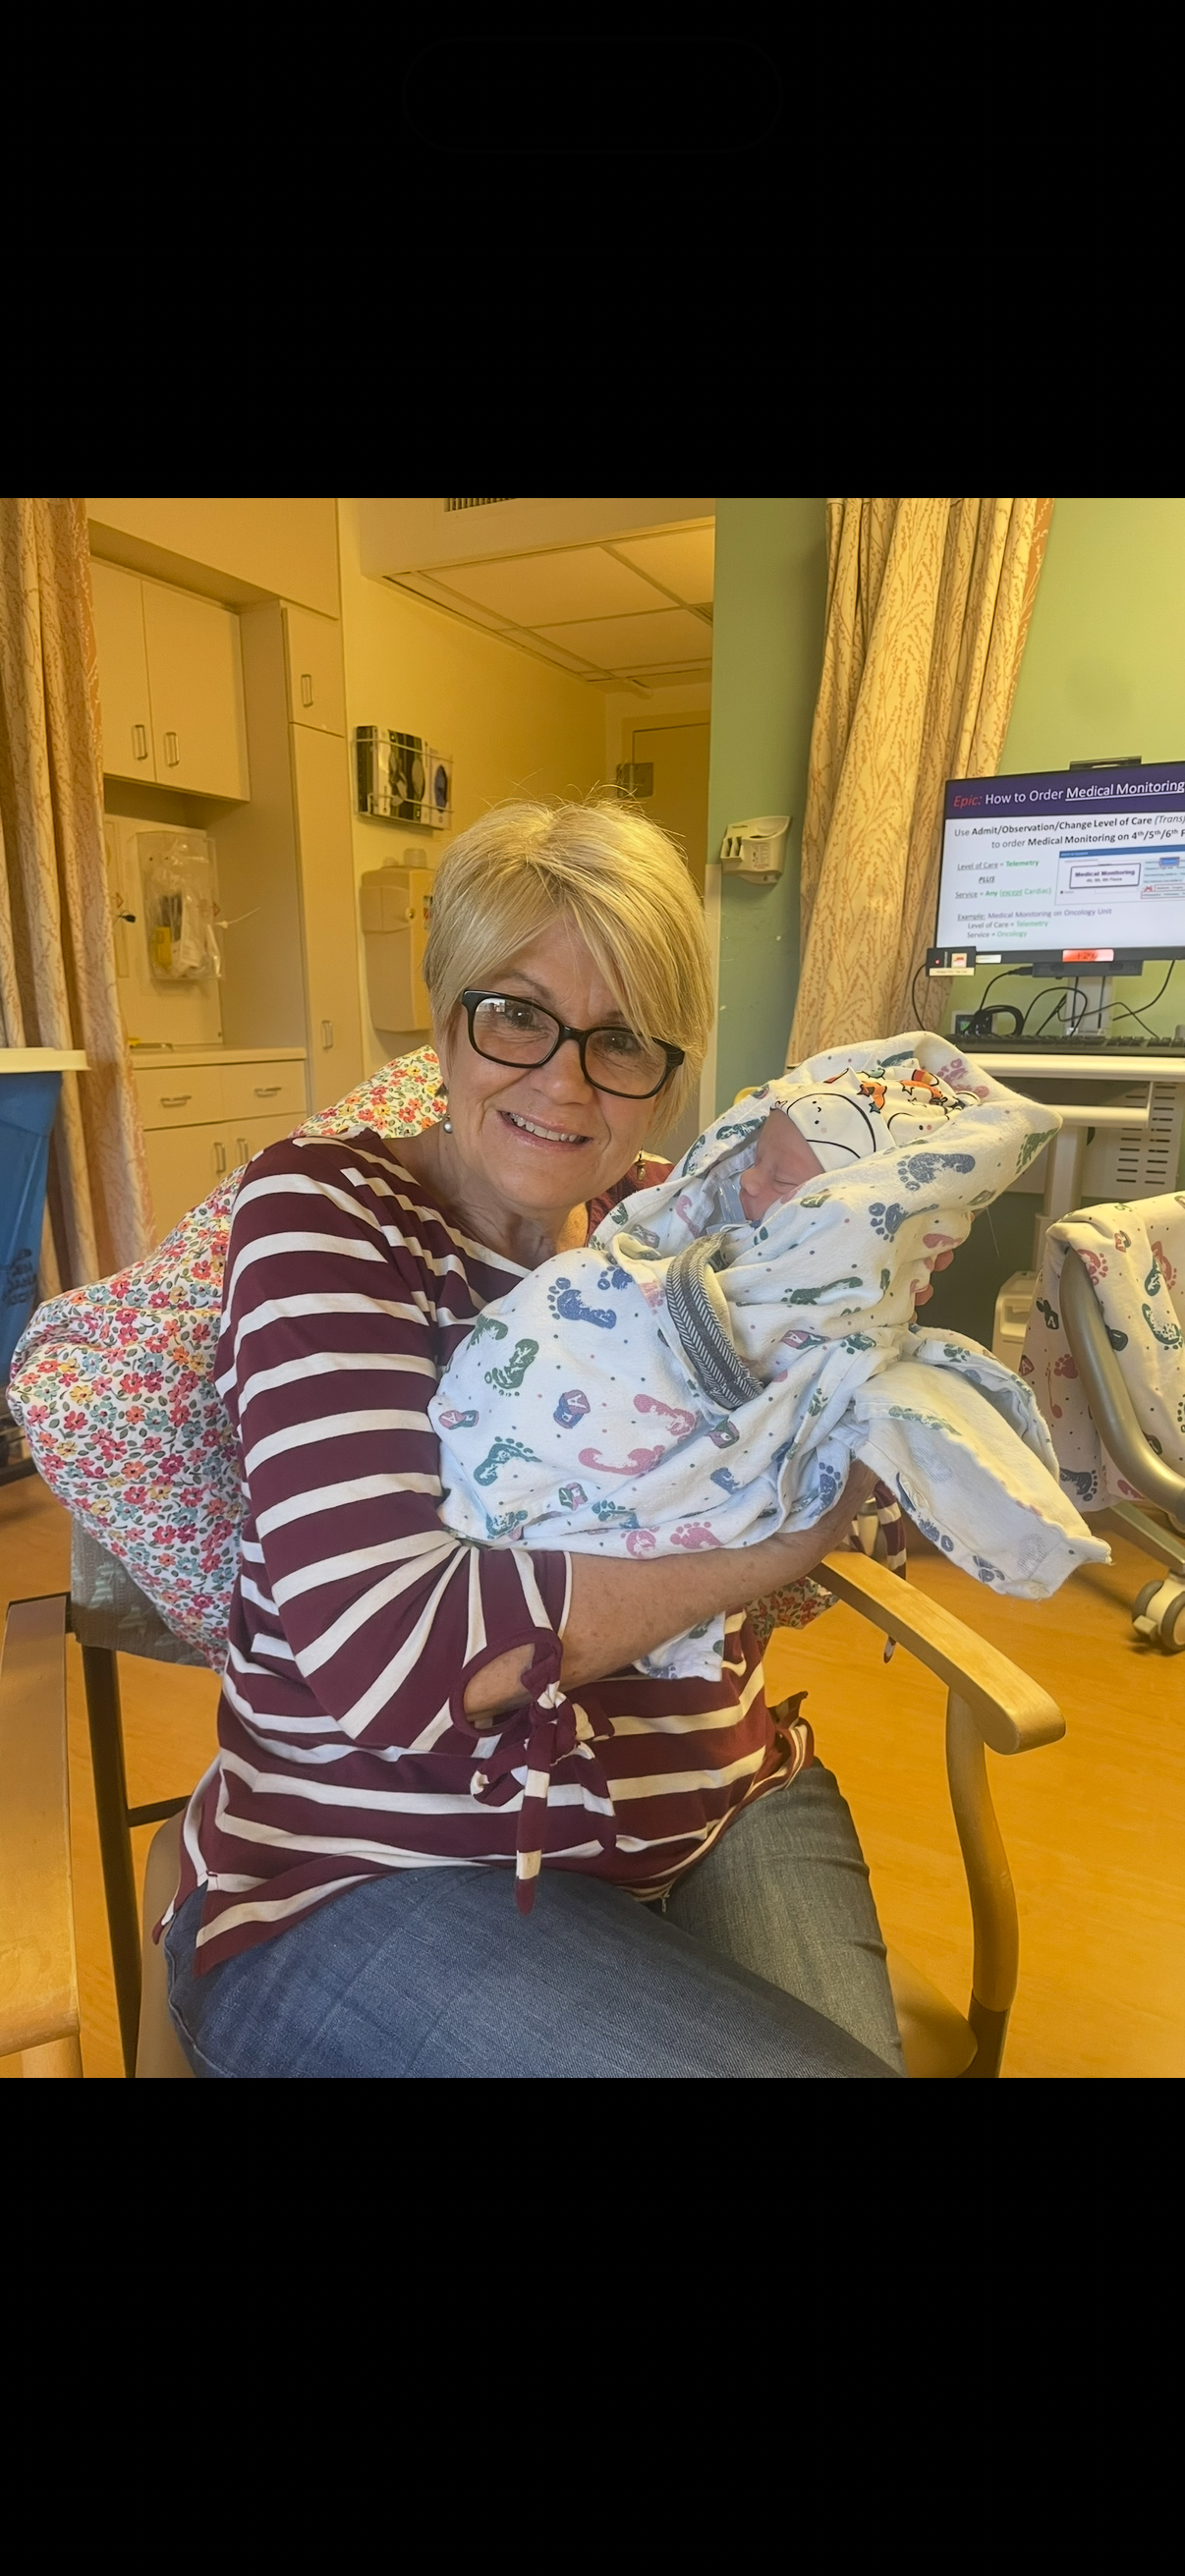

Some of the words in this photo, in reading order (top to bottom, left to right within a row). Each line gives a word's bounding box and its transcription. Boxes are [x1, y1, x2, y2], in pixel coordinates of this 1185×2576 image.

[953, 794, 982, 809] Epic:
[985, 794, 1011, 805] How
[1014, 793, 1026, 803] to
[1029, 789, 1064, 802] Order
[1066, 784, 1113, 799] Medical
[1116, 780, 1185, 795] Monitoring
[972, 821, 1092, 835] Admit/Observation/Change
[1094, 817, 1117, 828] Level
[1119, 817, 1129, 826] of
[1131, 816, 1153, 825] Care
[1002, 839, 1026, 848] order
[1028, 836, 1062, 846] Medical
[1065, 833, 1115, 844] Monitoring
[979, 875, 995, 884] PLUS
[1015, 911, 1051, 920] Monitoring
